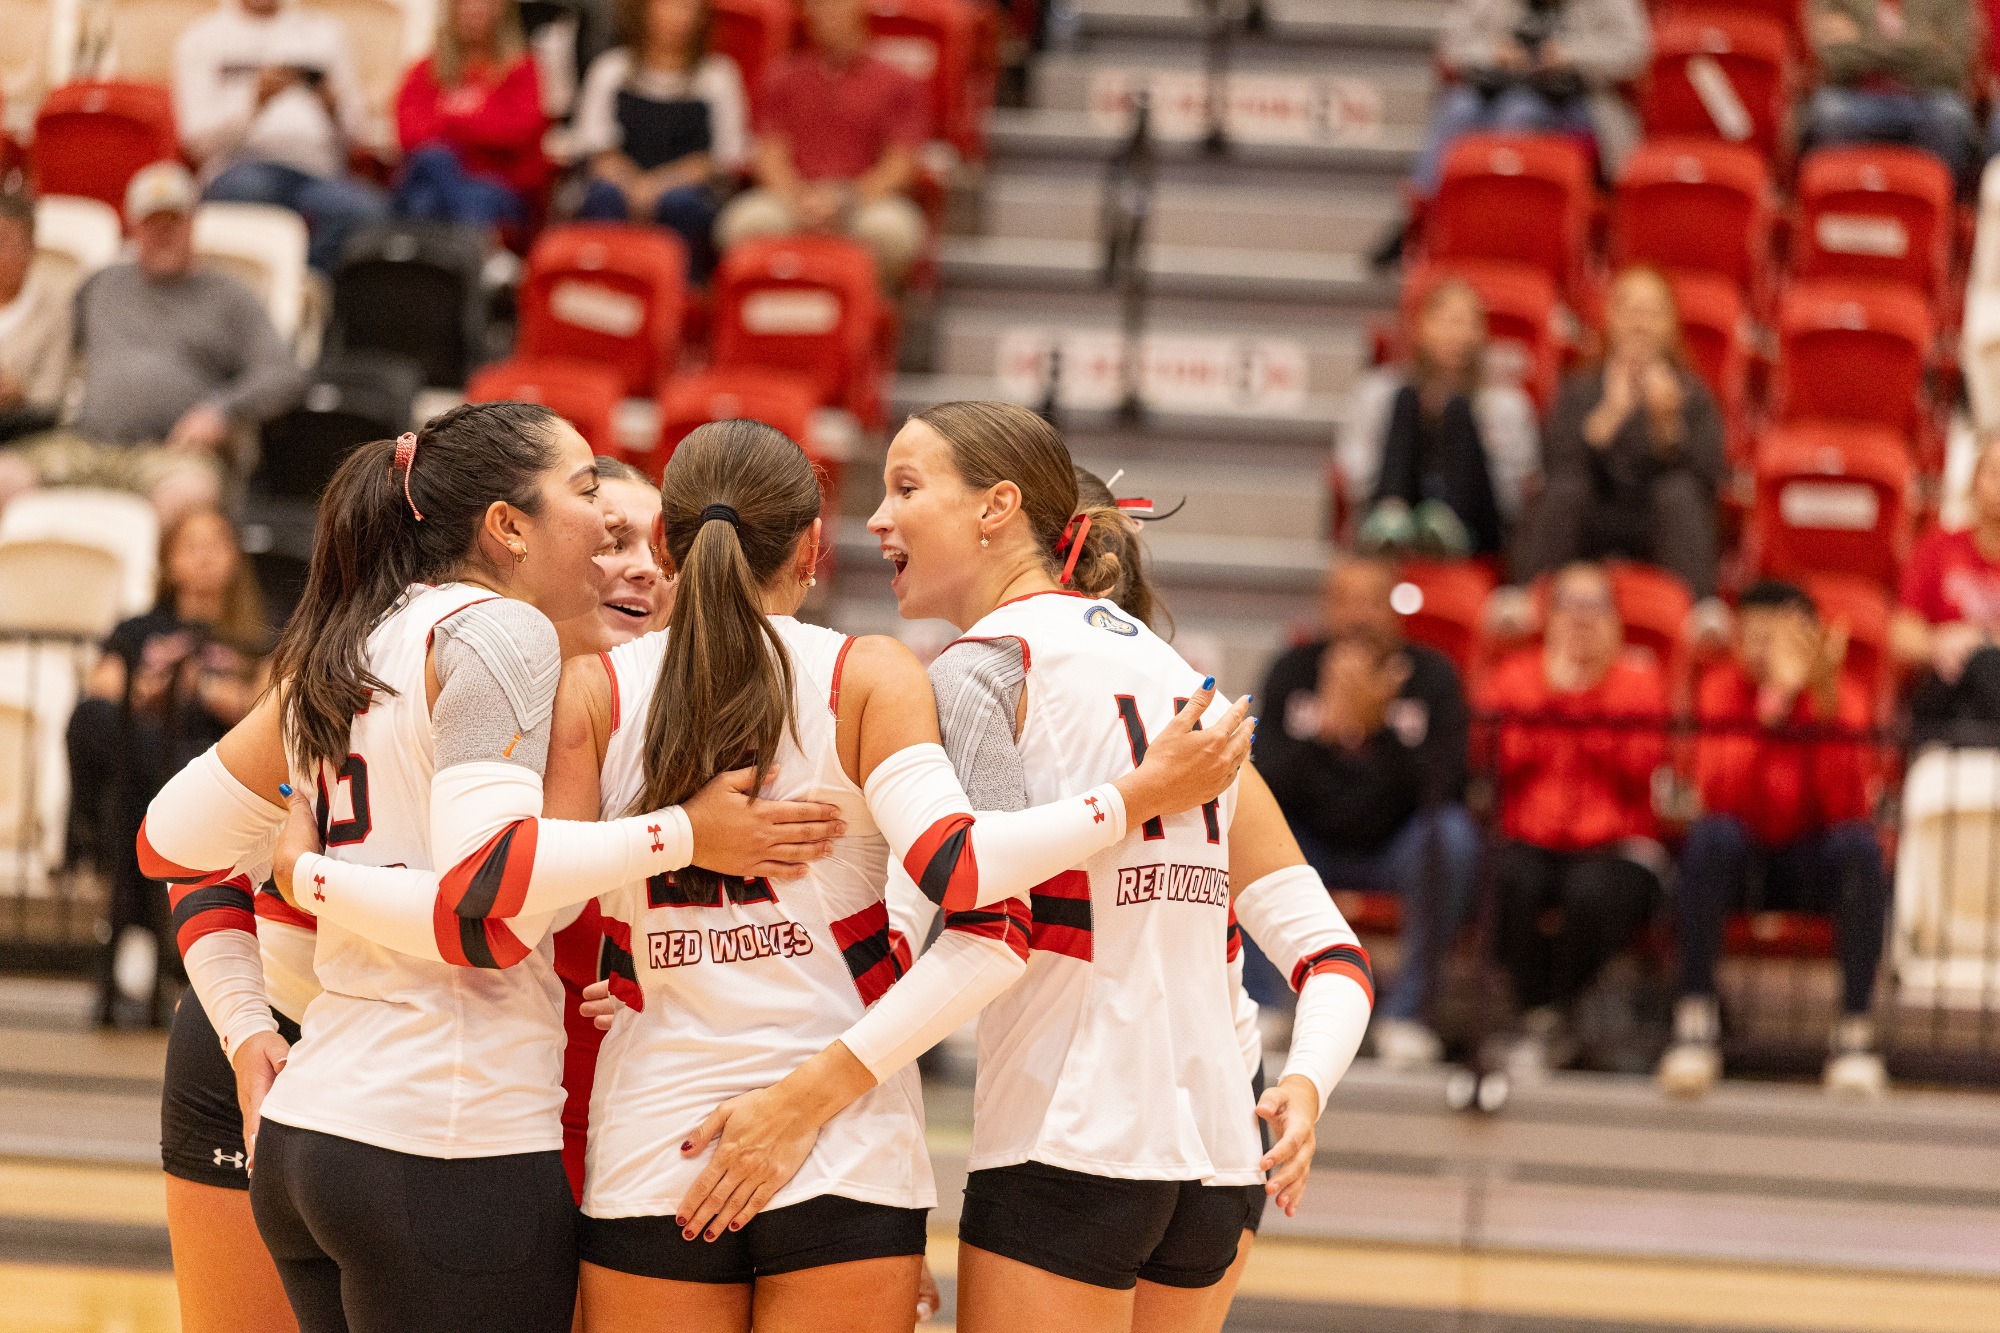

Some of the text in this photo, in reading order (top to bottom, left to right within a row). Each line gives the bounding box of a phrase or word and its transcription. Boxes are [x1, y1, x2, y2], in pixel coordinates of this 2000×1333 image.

[1116, 863, 1165, 906] RED
[647, 920, 814, 969] RED WOLVES
